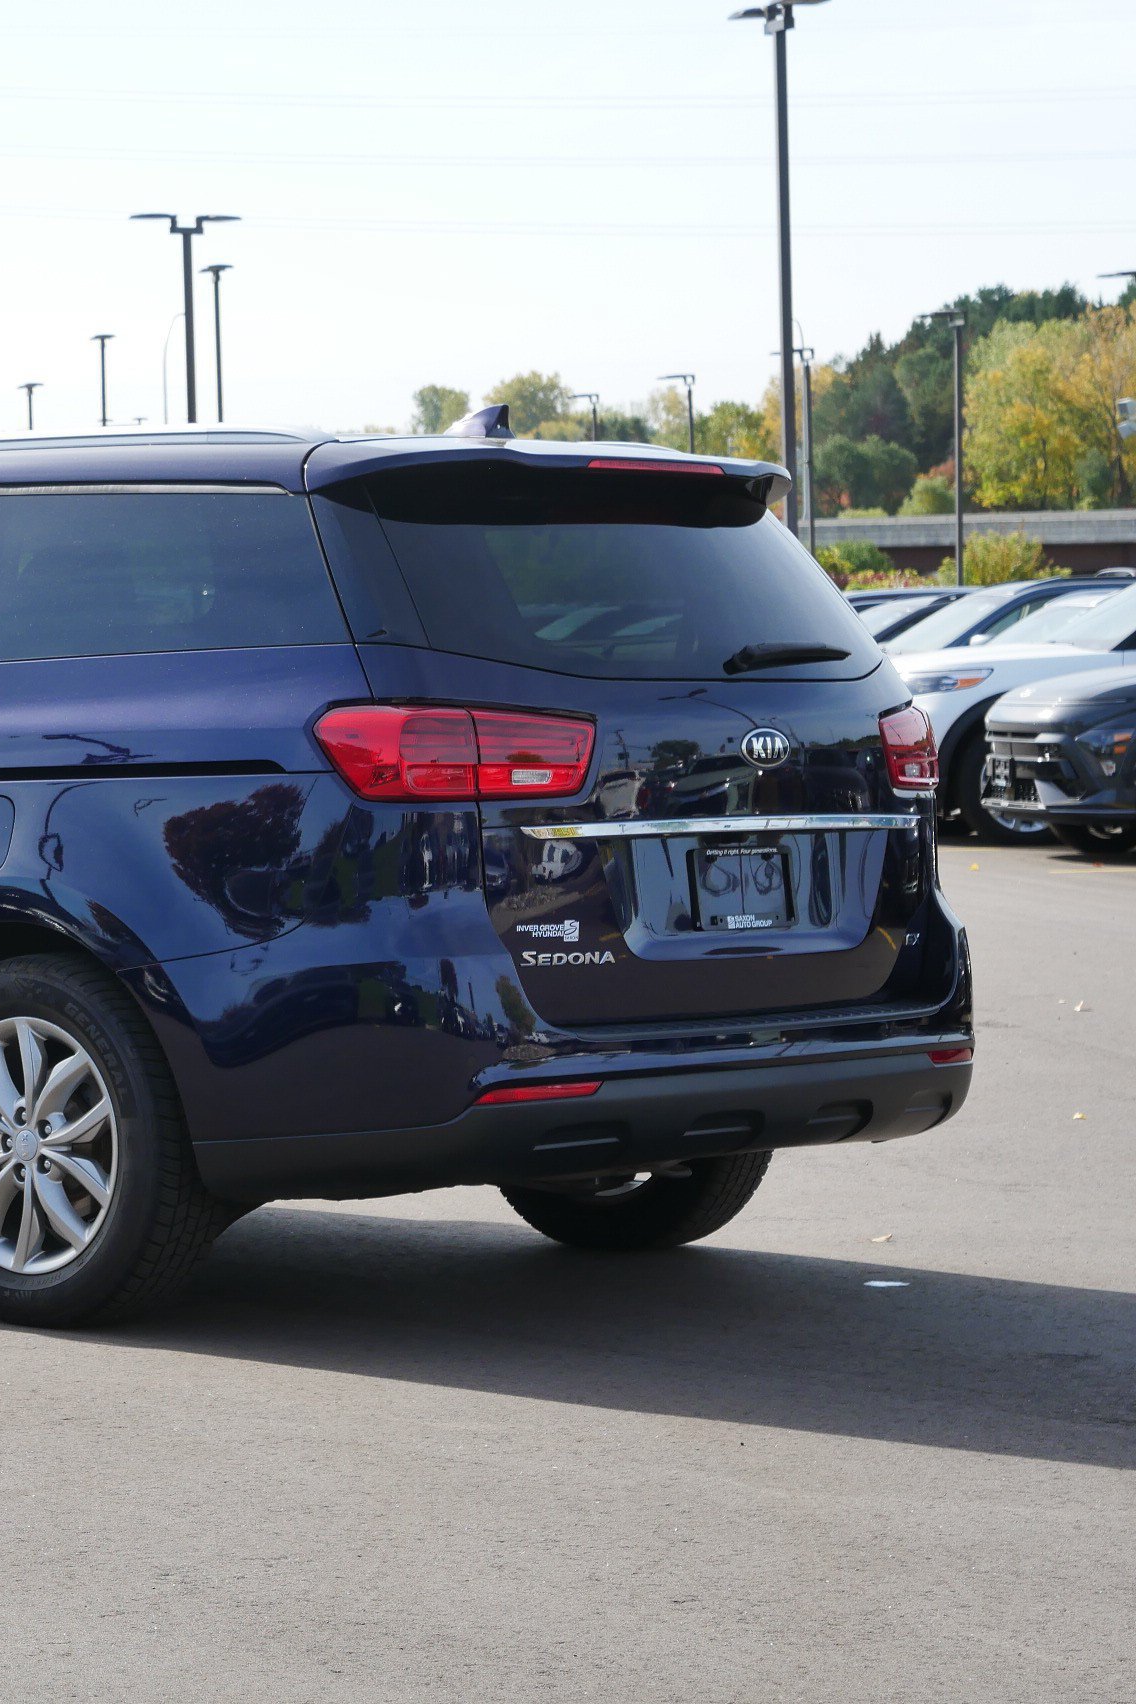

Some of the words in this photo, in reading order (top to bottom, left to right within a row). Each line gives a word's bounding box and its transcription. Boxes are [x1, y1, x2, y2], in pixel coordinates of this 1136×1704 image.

[750, 736, 784, 759] KIA
[516, 924, 539, 932] INVER
[539, 924, 564, 932] GROVE
[735, 920, 752, 929] AUTO
[751, 919, 773, 928] GROUP
[520, 950, 616, 967] SEDONA
